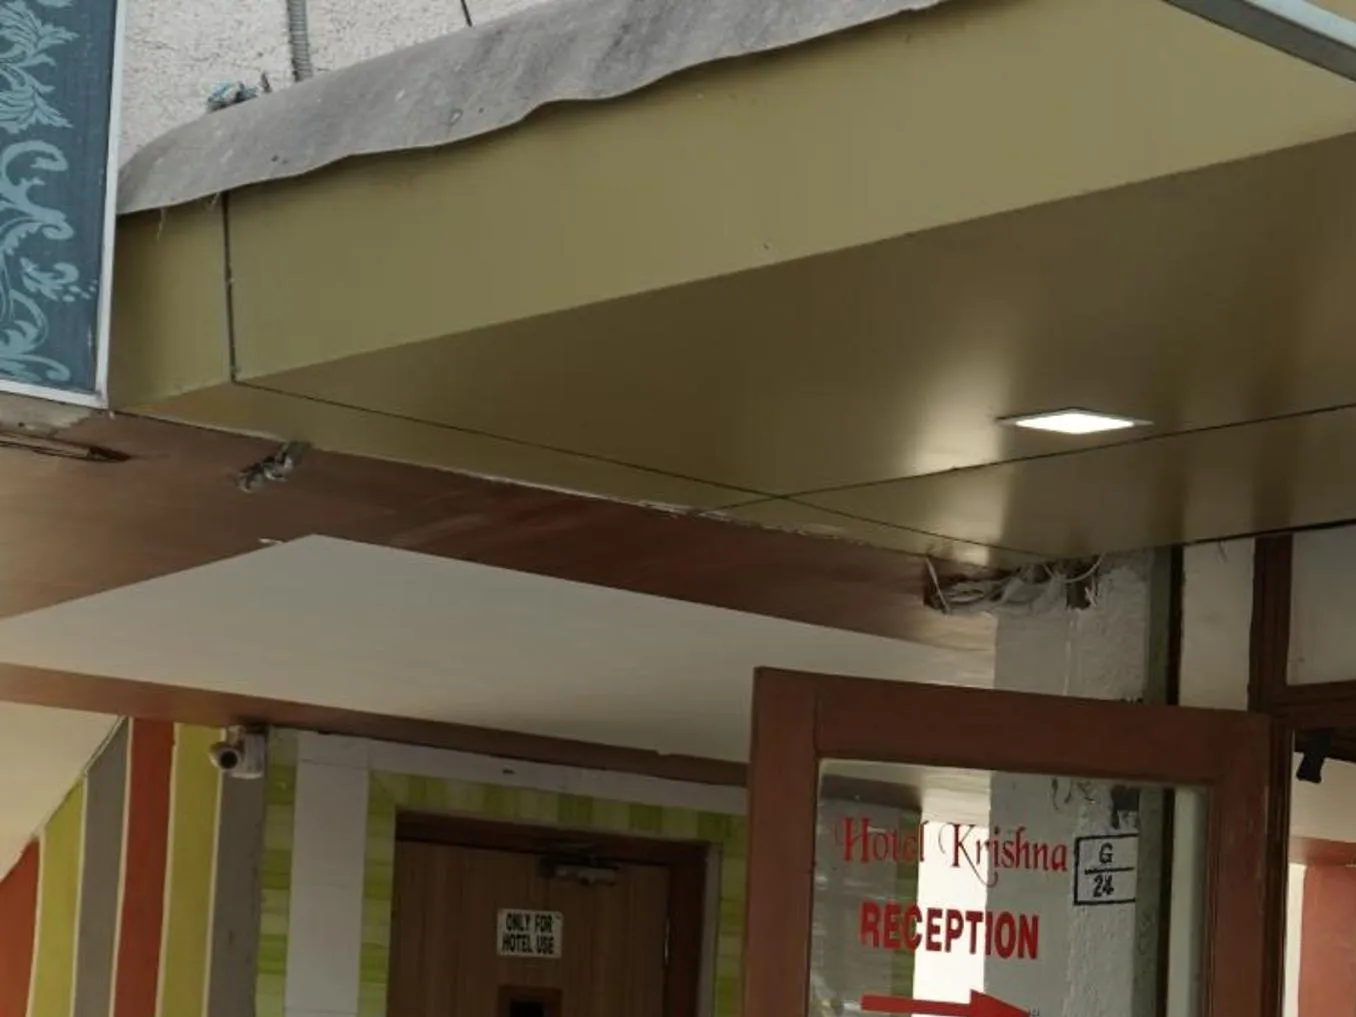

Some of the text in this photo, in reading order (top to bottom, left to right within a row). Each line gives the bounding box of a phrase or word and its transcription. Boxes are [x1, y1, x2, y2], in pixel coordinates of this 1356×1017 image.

[836, 816, 1069, 888] Hotel Krishna
[1099, 843, 1114, 864] G
[1092, 874, 1115, 898] 24
[506, 912, 552, 933] ONLY FOR
[860, 901, 1040, 960] RECEPTION
[502, 933, 533, 953] HOTEL
